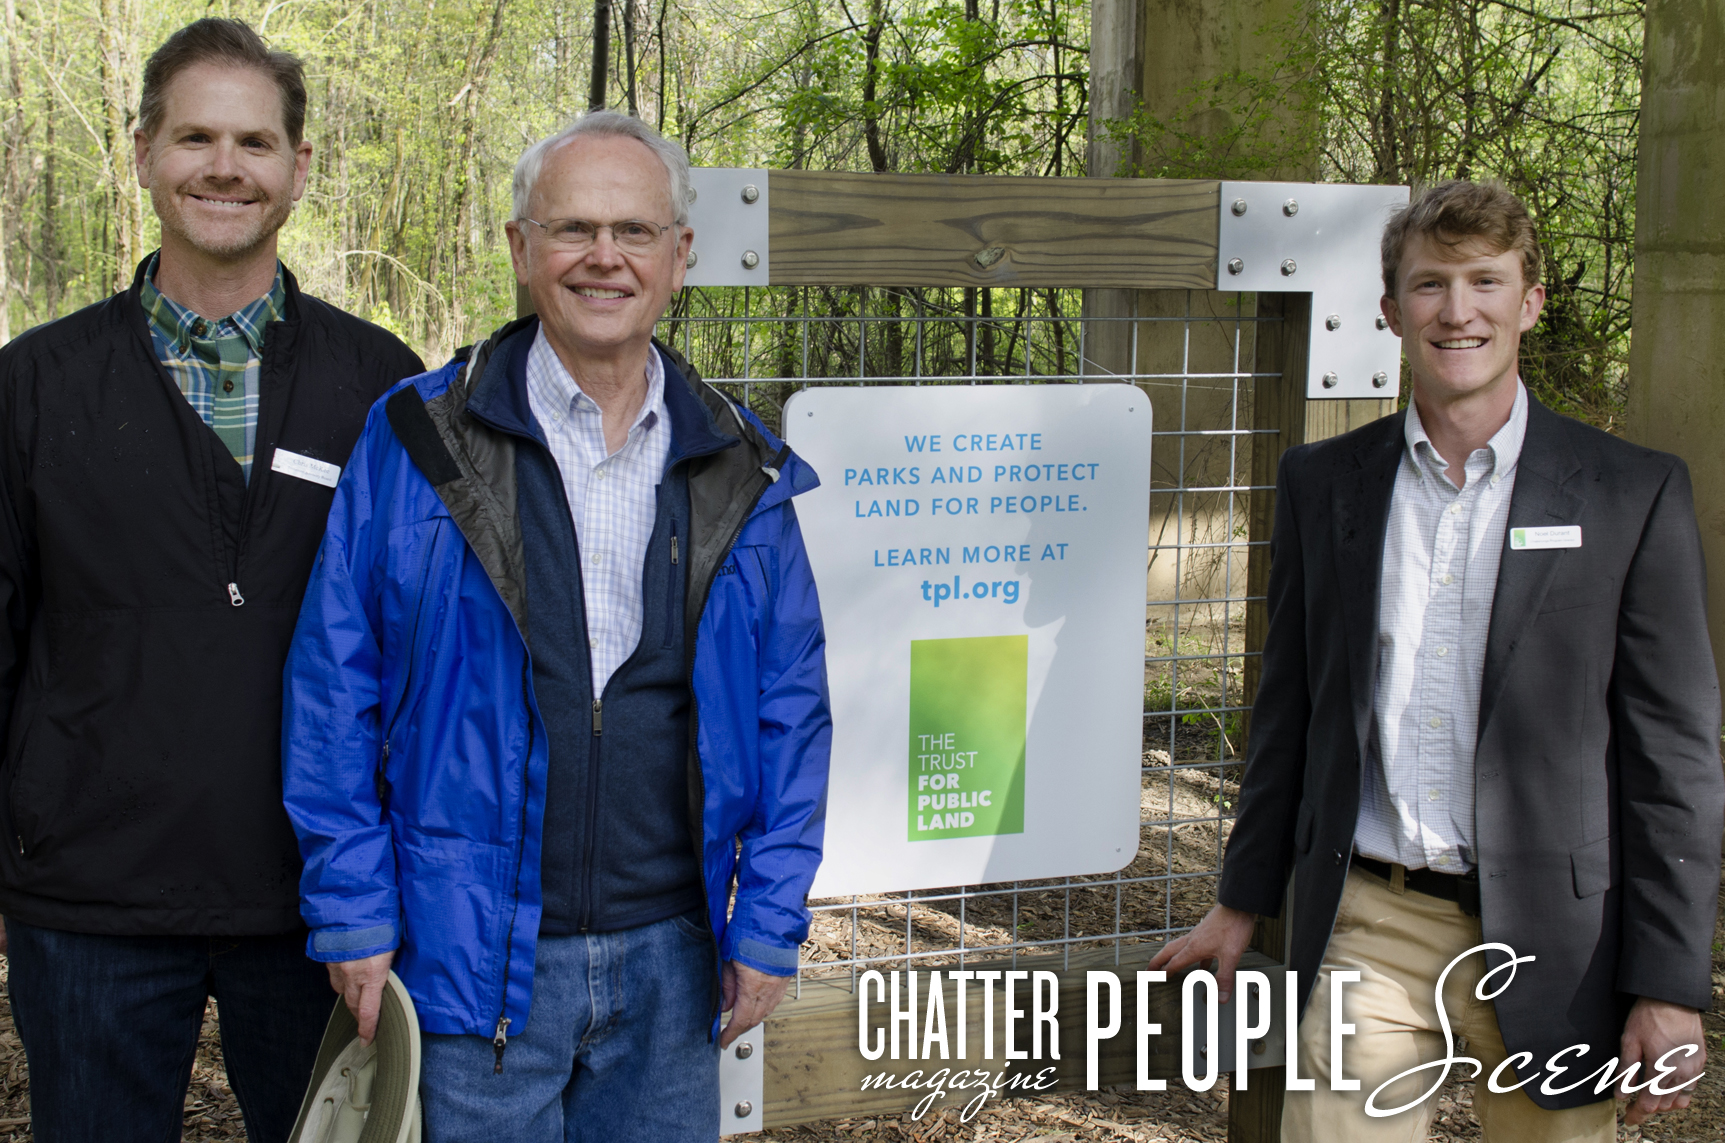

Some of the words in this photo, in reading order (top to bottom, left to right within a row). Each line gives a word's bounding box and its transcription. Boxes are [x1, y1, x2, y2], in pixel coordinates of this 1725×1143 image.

[904, 434, 942, 453] WE
[952, 433, 1042, 453] CREATE
[844, 466, 921, 487] PARKS
[930, 465, 983, 485] AND
[994, 463, 1100, 483] PROTECT
[855, 499, 921, 518] LAND
[931, 497, 979, 516] FOR
[990, 494, 1088, 515] PEOPLE.
[873, 547, 951, 567] LEARN
[962, 545, 1031, 564] MORE
[1040, 543, 1070, 562] AT
[920, 575, 1020, 608] tpl.org
[918, 733, 955, 751] THE
[917, 751, 979, 771] TRUST
[918, 773, 960, 791] FOR
[917, 790, 992, 812] PUBLIC
[917, 811, 975, 832] LAND
